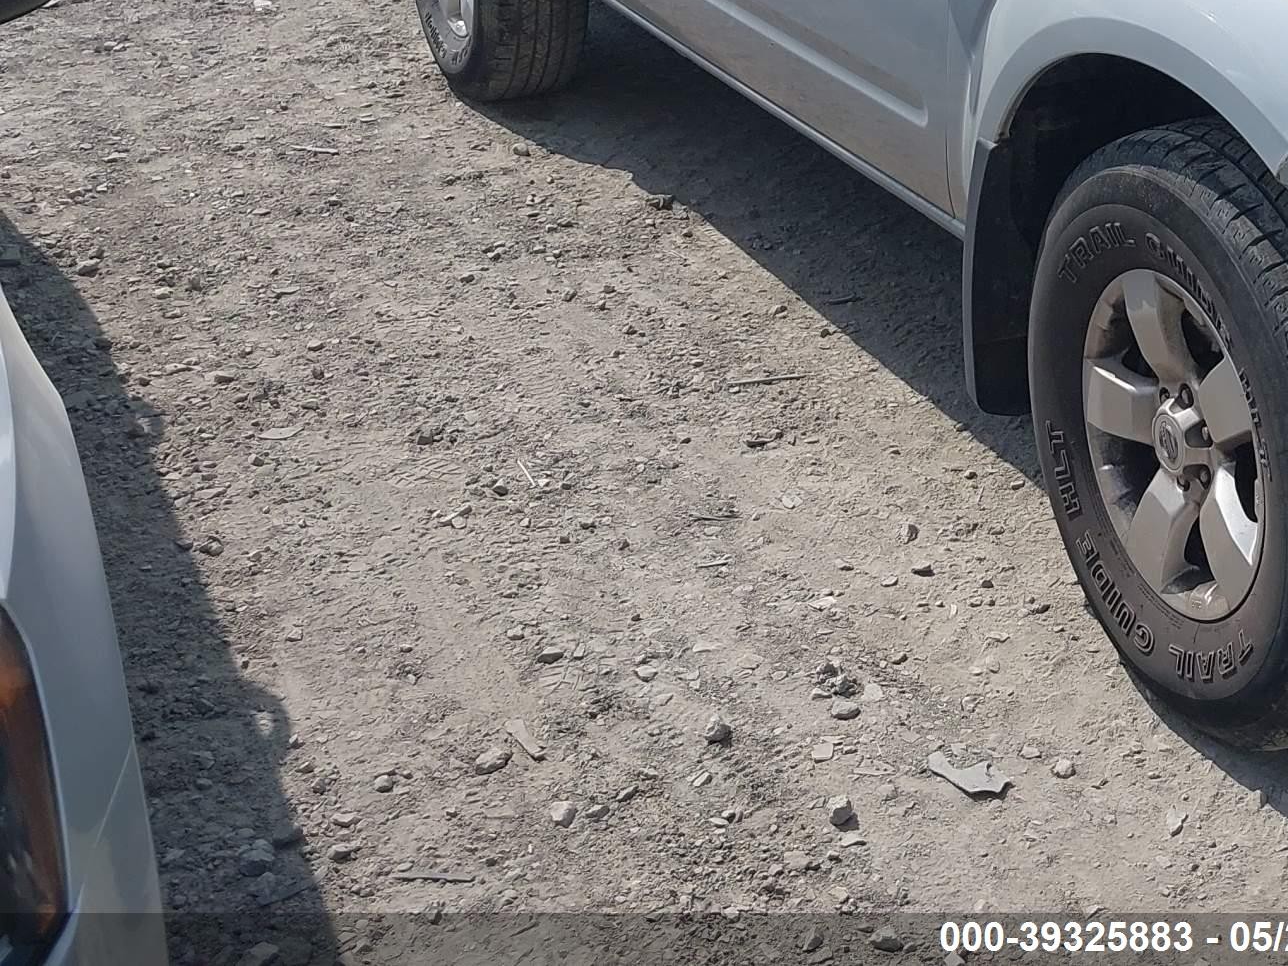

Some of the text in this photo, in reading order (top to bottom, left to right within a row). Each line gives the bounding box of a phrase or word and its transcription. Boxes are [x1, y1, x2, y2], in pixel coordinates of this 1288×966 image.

[1058, 222, 1136, 283] TRAIL
[1046, 420, 1254, 683] TRAIL GUIDE HLT
